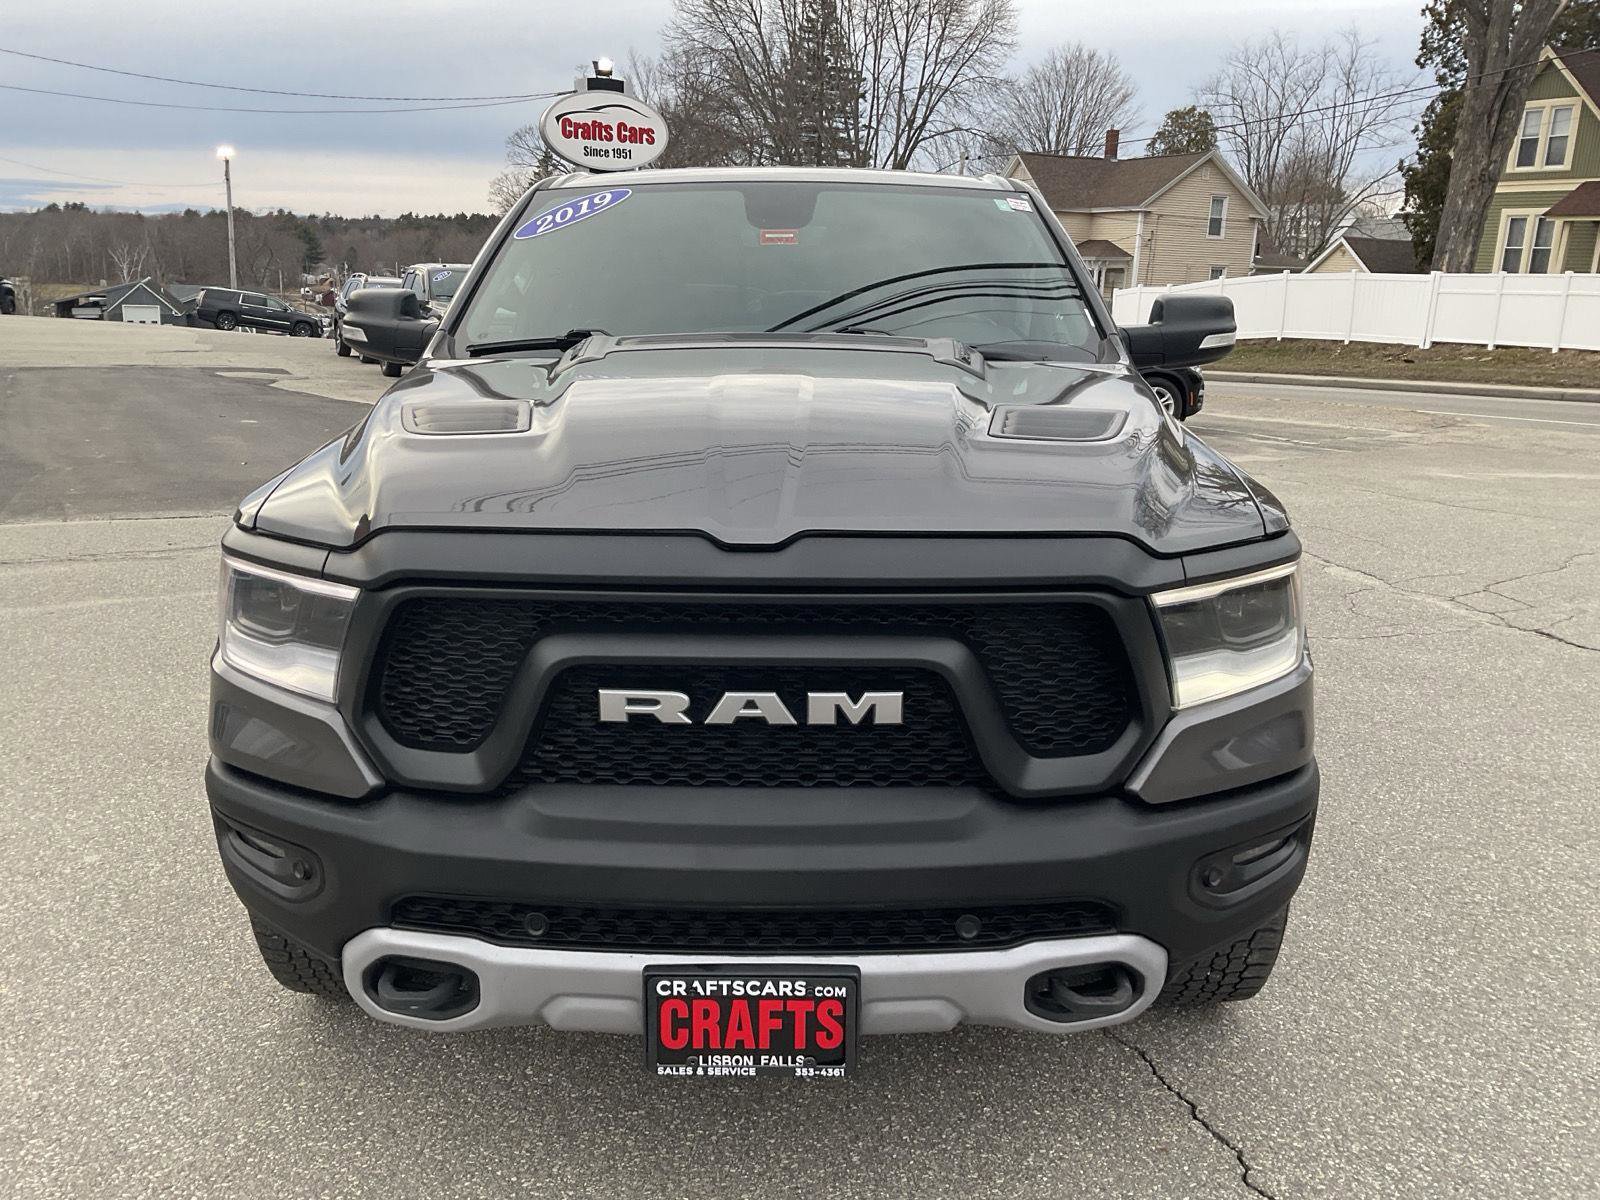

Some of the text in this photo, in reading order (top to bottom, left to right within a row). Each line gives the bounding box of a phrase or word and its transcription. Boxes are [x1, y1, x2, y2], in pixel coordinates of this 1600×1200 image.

[561, 117, 656, 145] Crafts Cars
[583, 146, 632, 160] Since 1951
[536, 192, 612, 234] 2019
[598, 689, 904, 725] RAM
[660, 998, 844, 1050] CRAFTS
[657, 1067, 845, 1077] SALES & SERVICE 353-4361
[699, 1055, 805, 1067] LISBON FALLS
